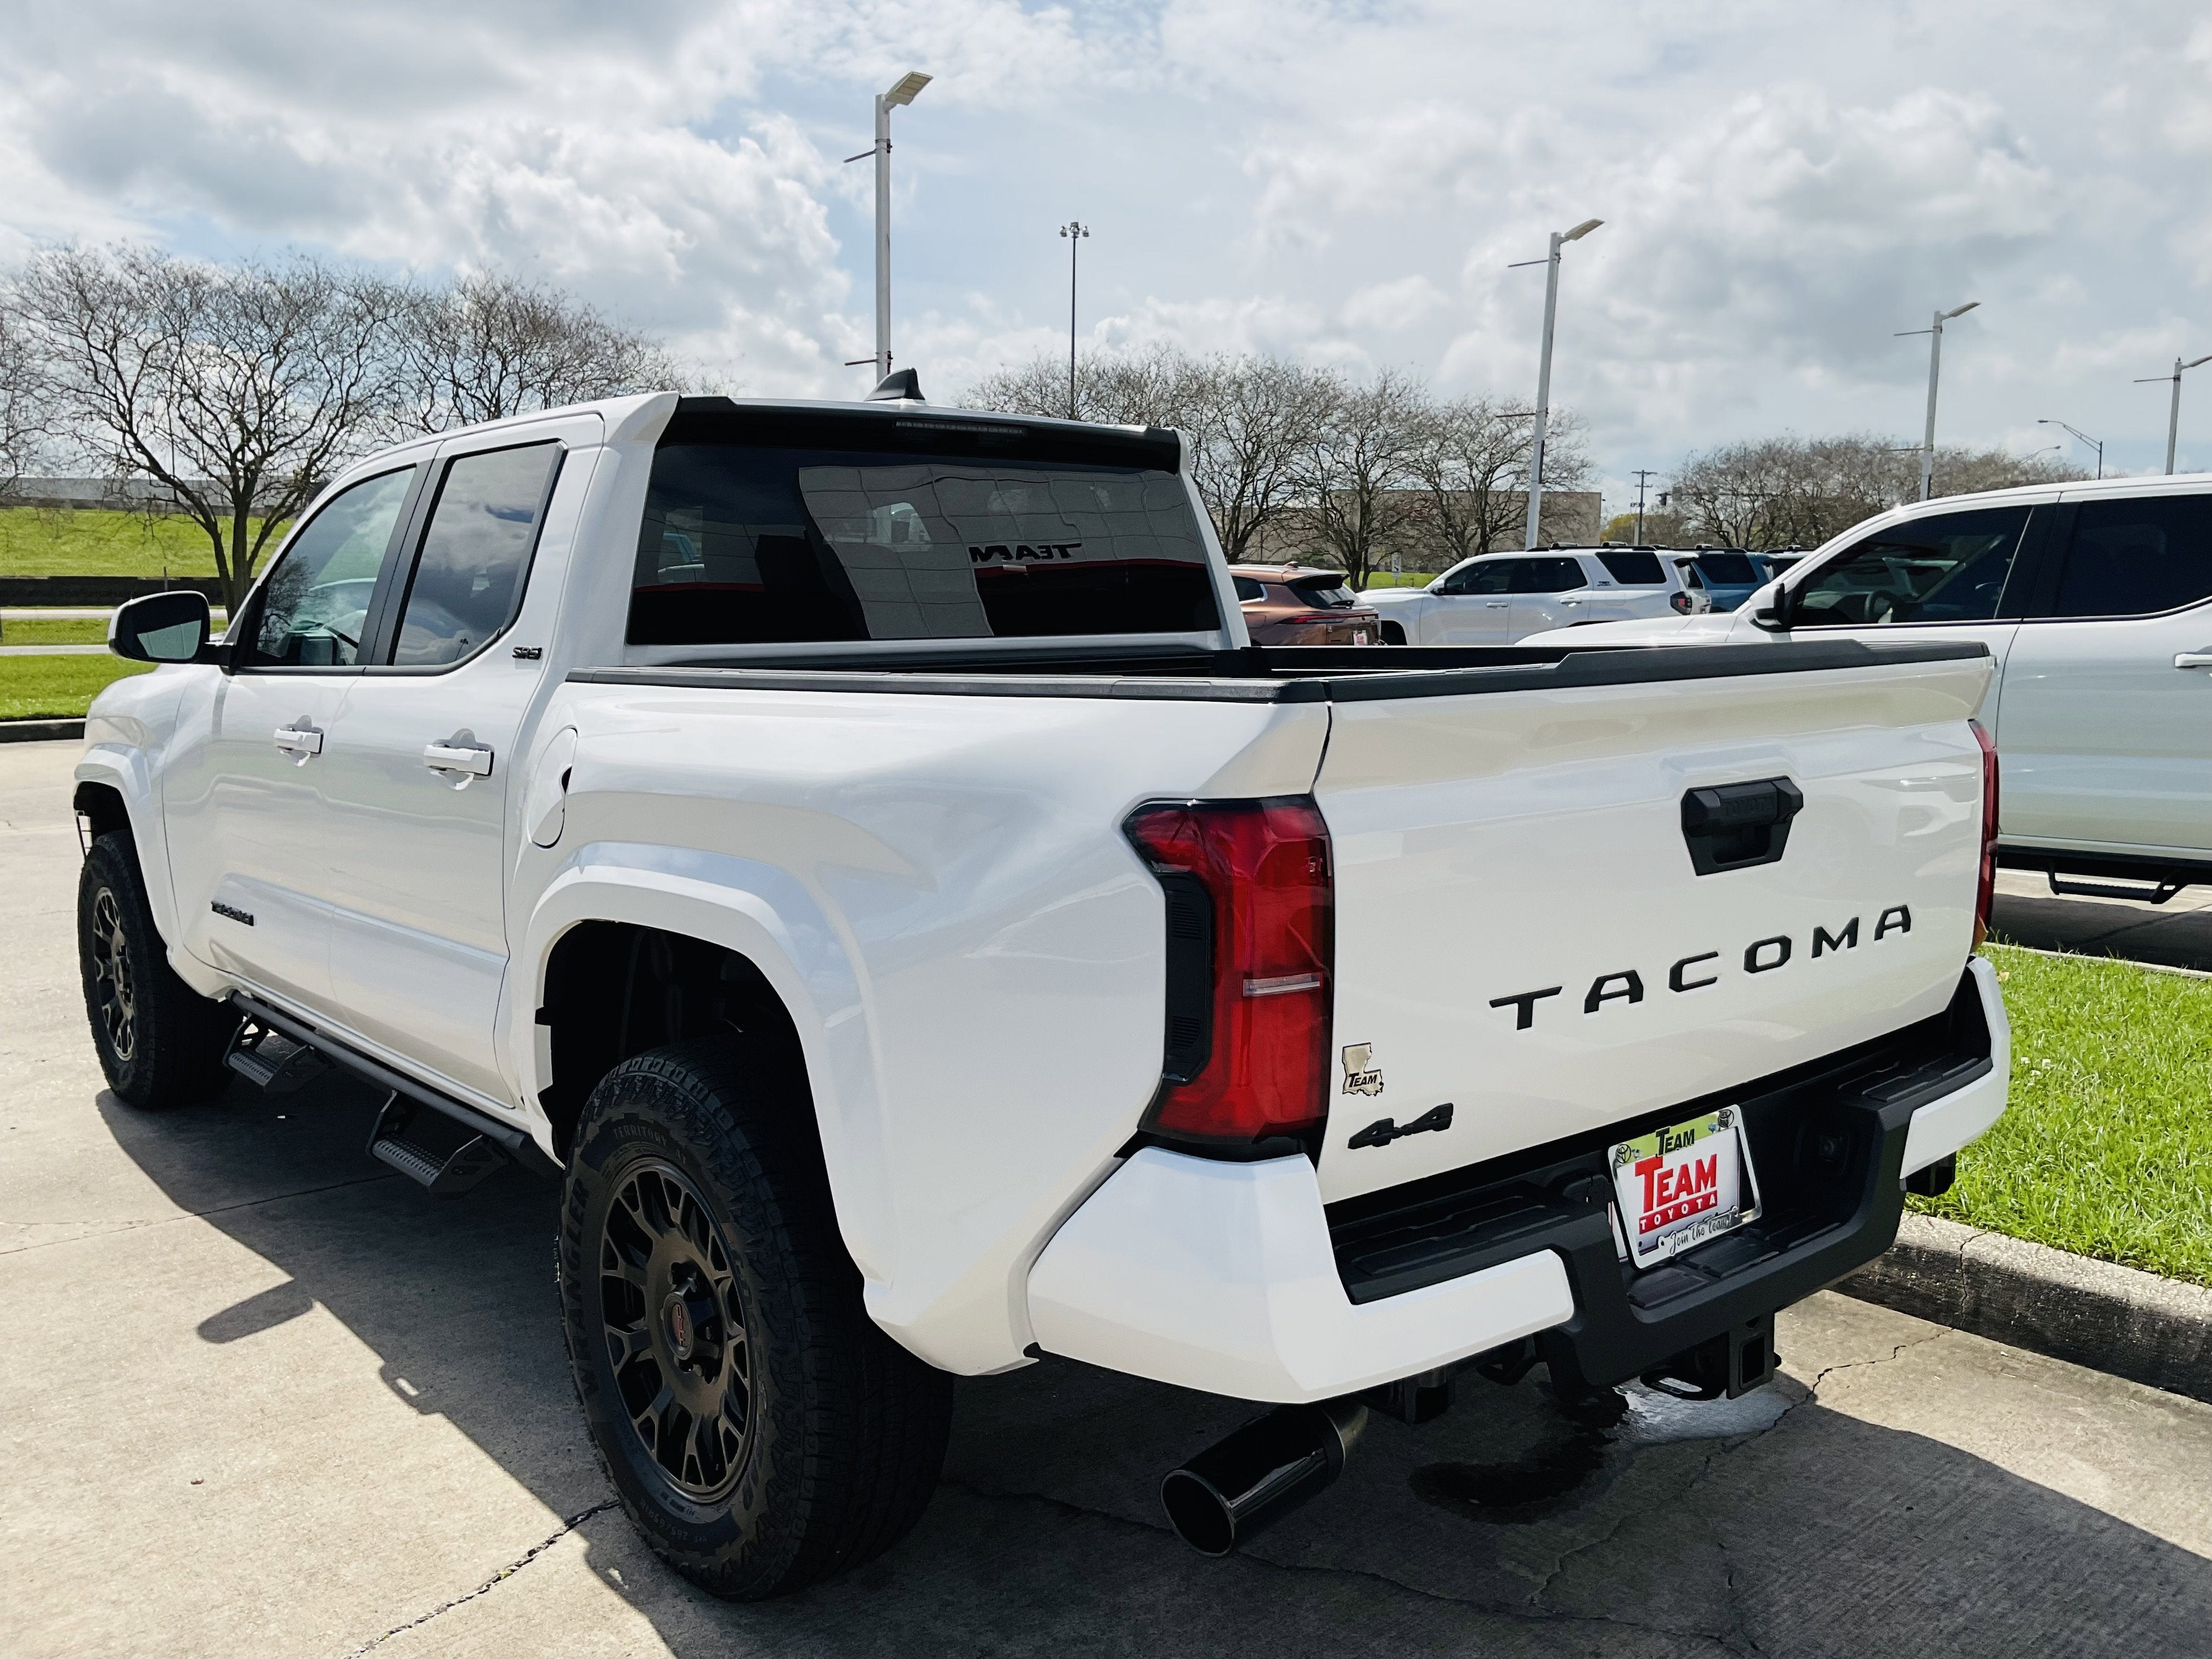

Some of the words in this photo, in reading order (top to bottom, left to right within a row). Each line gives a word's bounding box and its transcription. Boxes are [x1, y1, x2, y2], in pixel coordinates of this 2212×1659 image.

[1489, 904, 1912, 1031] TACOMA
[1348, 1072, 1378, 1088] TEAM
[612, 1125, 667, 1147] TERRITORY
[1655, 1127, 1695, 1156] TEAM
[1635, 1153, 1717, 1214] TEAM
[1640, 1193, 1716, 1231] TOYOTA
[1669, 1232, 1689, 1255] Join
[565, 1177, 600, 1398] WRANGLER
[676, 1304, 685, 1347] TRD
